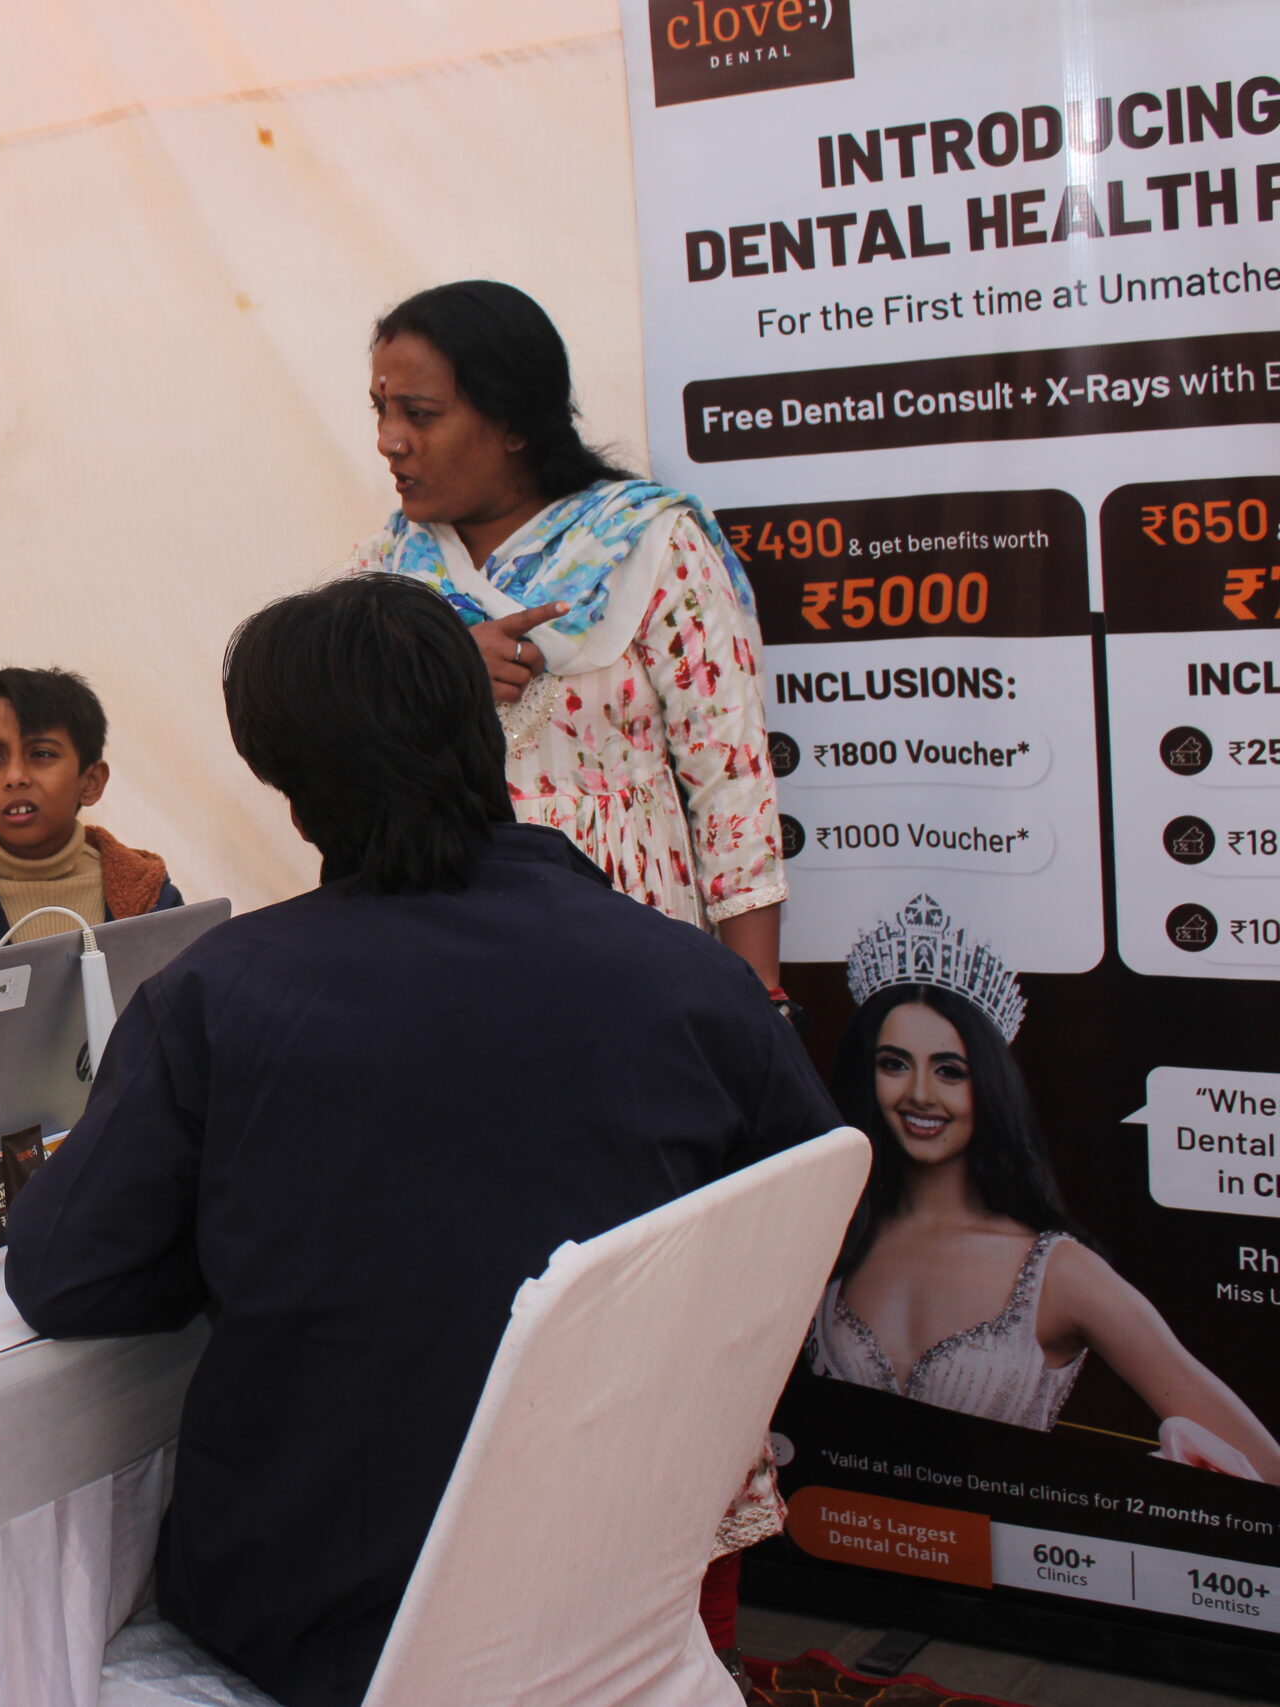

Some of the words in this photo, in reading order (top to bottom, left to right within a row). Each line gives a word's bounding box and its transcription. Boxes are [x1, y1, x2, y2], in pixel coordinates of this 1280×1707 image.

[710, 45, 791, 69] DENTAL
[818, 75, 1280, 189] INTRODUCING
[685, 204, 951, 283] DENTAL
[966, 167, 1239, 252] HEALTH
[756, 308, 812, 338] For
[819, 301, 875, 331] the
[884, 293, 964, 326] First
[973, 285, 1043, 317] time
[1051, 280, 1088, 309] at
[702, 403, 773, 435] Free
[782, 392, 886, 429] Dental
[893, 382, 1014, 418] Consult
[1020, 386, 1038, 405] +
[1046, 370, 1170, 407] X-Rays
[1179, 362, 1256, 397] with
[1141, 498, 1268, 546] ₹650
[730, 517, 844, 562] ₹490
[848, 538, 863, 557] &
[869, 537, 902, 559] get
[907, 531, 990, 552] benefits
[993, 530, 1050, 550] worth
[800, 571, 989, 630] ₹5000
[775, 666, 1017, 704] INCLUSIONS:
[813, 741, 897, 768] ₹1800
[816, 824, 900, 851] ₹1000
[1177, 1126, 1275, 1157] Dental
[1218, 1169, 1244, 1195] in
[1217, 1282, 1265, 1304] Miss
[872, 1460, 889, 1474] at
[893, 1463, 912, 1479] all
[916, 1466, 963, 1488] Clove
[967, 1474, 1025, 1498] Dental
[1029, 1483, 1089, 1506] clinics
[1094, 1492, 1120, 1510] for
[1125, 1498, 1144, 1514] 12
[1148, 1503, 1220, 1527] months
[1225, 1513, 1273, 1535] from
[887, 1518, 958, 1544] Largest
[828, 1530, 890, 1554] Dental
[895, 1542, 950, 1565] Chain
[1033, 1543, 1096, 1569] 600+
[1036, 1566, 1088, 1587] Clinics
[1187, 1569, 1270, 1599] 1400+
[1191, 1591, 1261, 1617] Dentists
